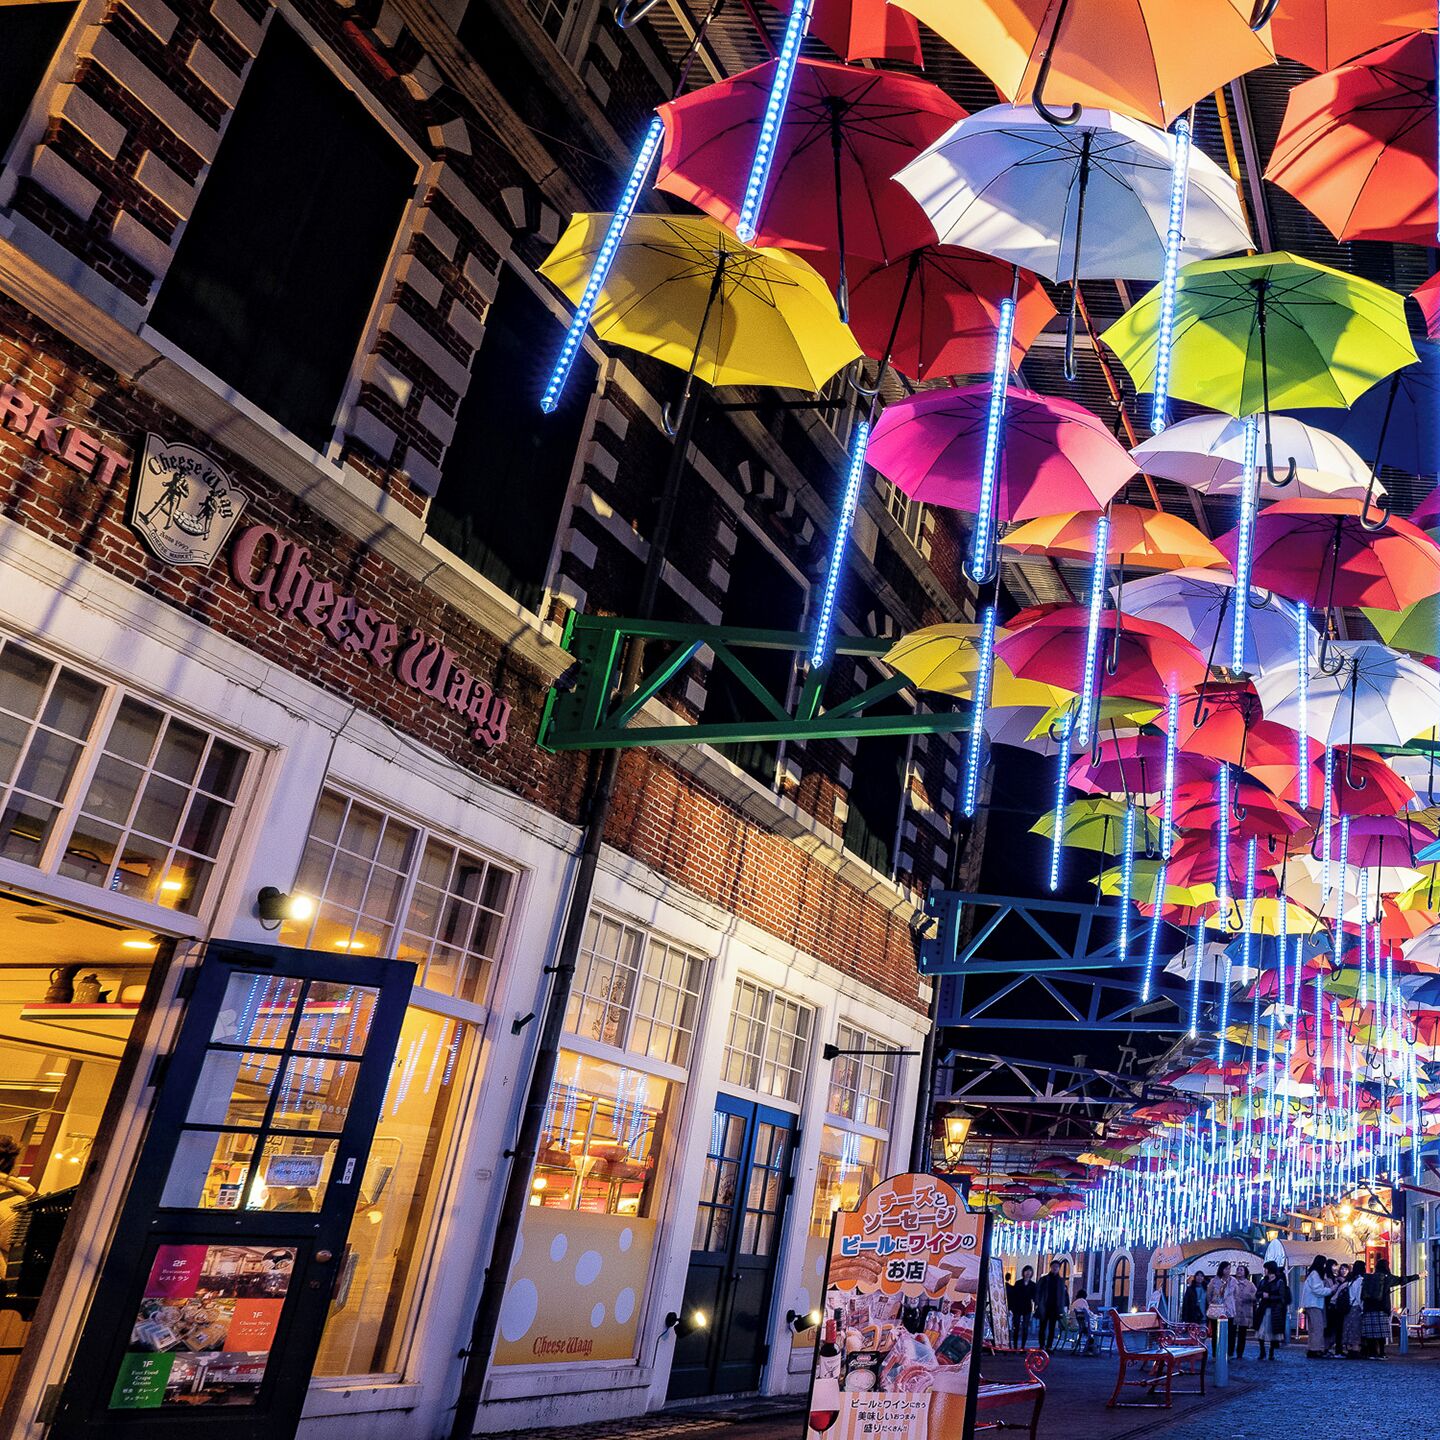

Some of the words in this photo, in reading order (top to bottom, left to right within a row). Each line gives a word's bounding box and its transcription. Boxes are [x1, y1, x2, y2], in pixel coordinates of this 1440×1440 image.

[148, 452, 203, 476] Cheese
[202, 467, 234, 518] Waag
[168, 552, 193, 560] MARKET
[232, 525, 399, 668] Cheese
[399, 628, 513, 748] Waag
[879, 1185, 946, 1213] チーズと
[863, 1206, 957, 1233] ソーセージ
[841, 1234, 976, 1256] ビールにワインの
[172, 1259, 187, 1267] 2F
[887, 1260, 926, 1281] お店
[252, 1311, 263, 1319] 1F
[533, 1336, 567, 1357] Cheese
[566, 1336, 593, 1357] Waag
[143, 1360, 154, 1368] 1F
[850, 1399, 927, 1410] ビールとワインに合う
[857, 1411, 917, 1422] 美味しいおつまみ
